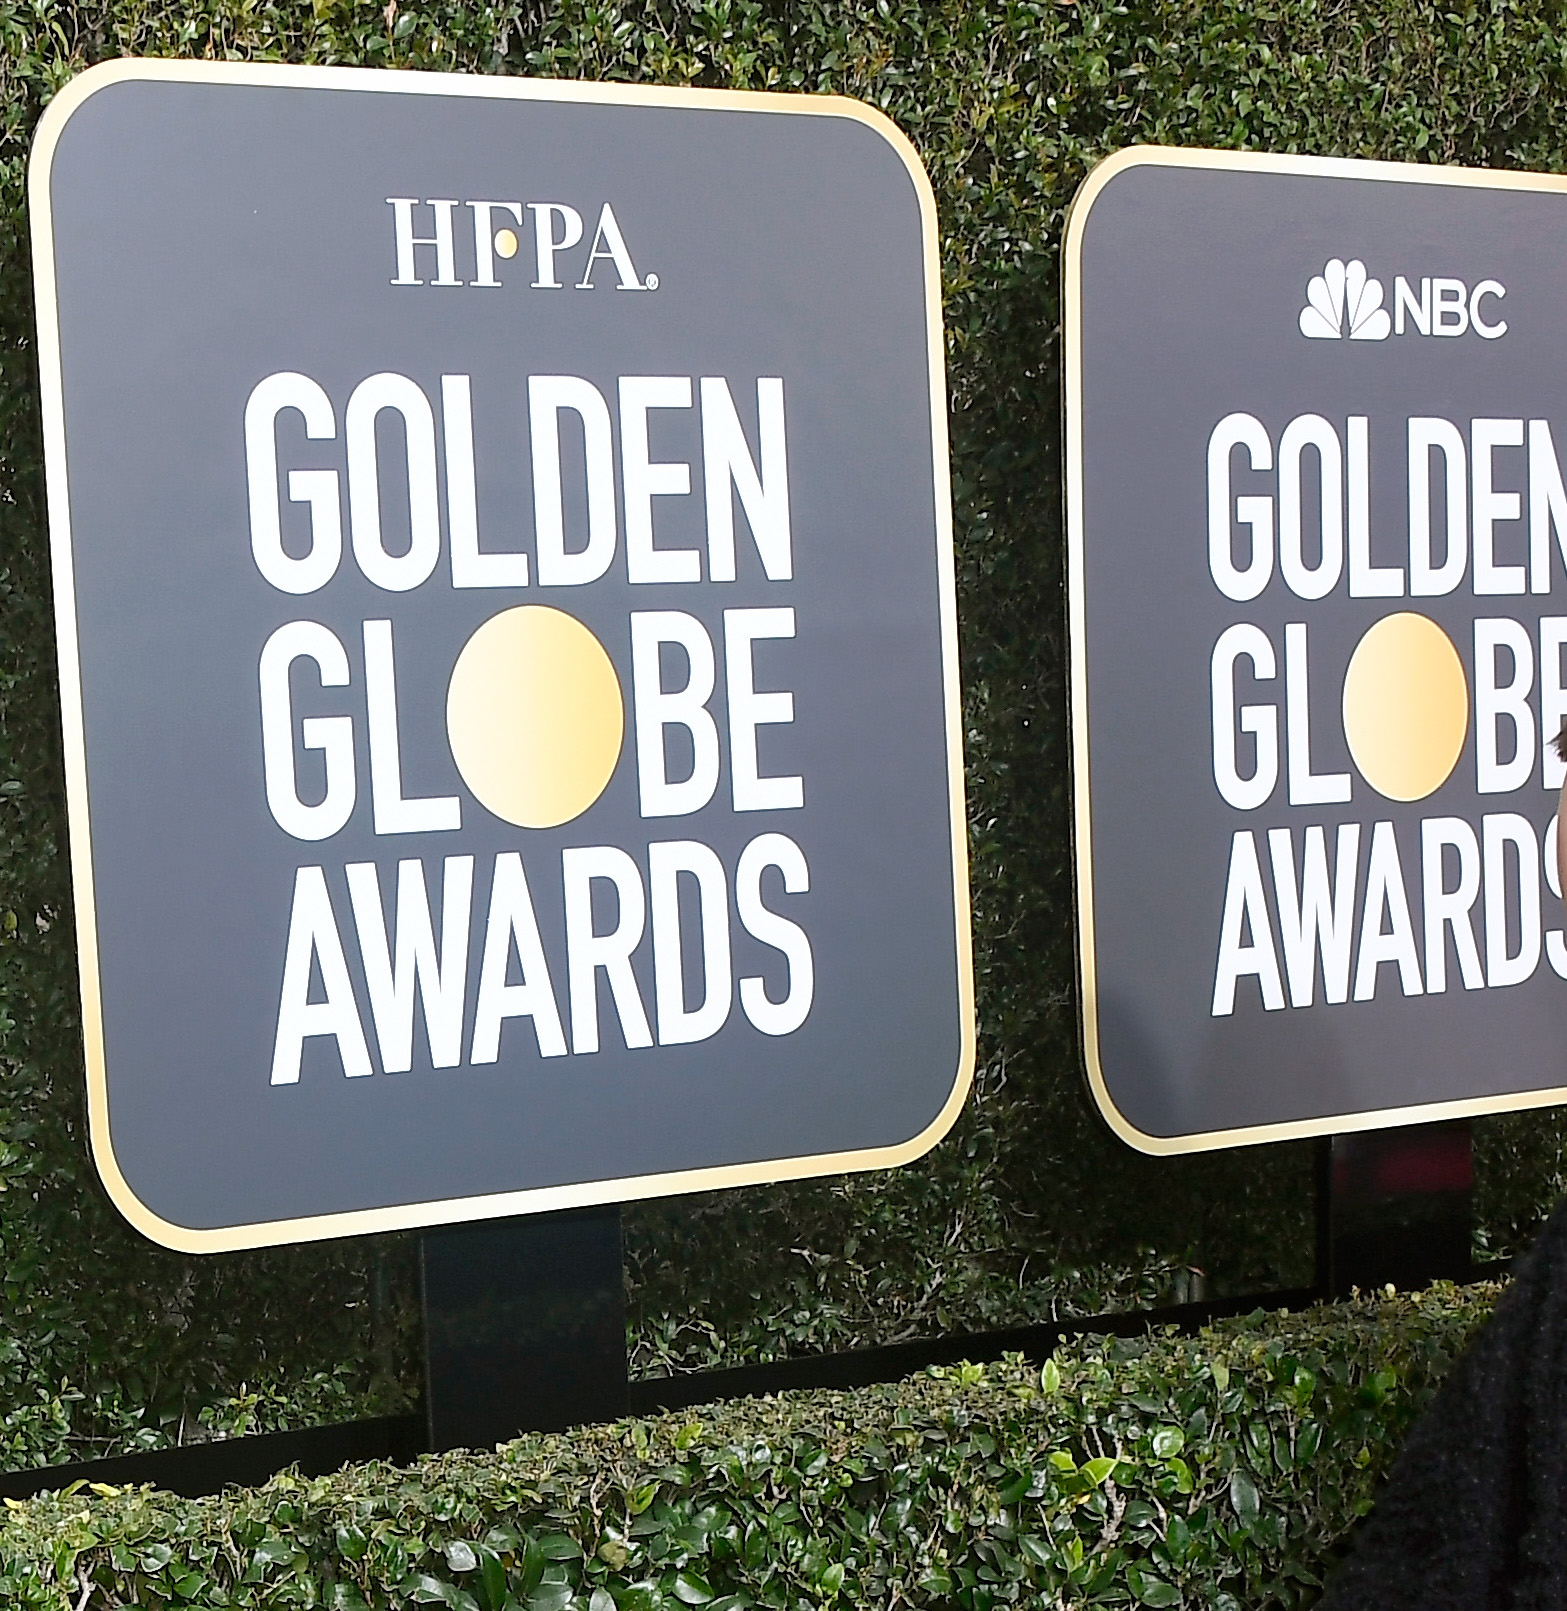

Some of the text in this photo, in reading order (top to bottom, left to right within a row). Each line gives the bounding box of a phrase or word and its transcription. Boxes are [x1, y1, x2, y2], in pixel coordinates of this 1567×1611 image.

[1394, 276, 1508, 339] NBC
[244, 372, 793, 593] GOLDEN
[270, 833, 815, 1086] AWARDS
